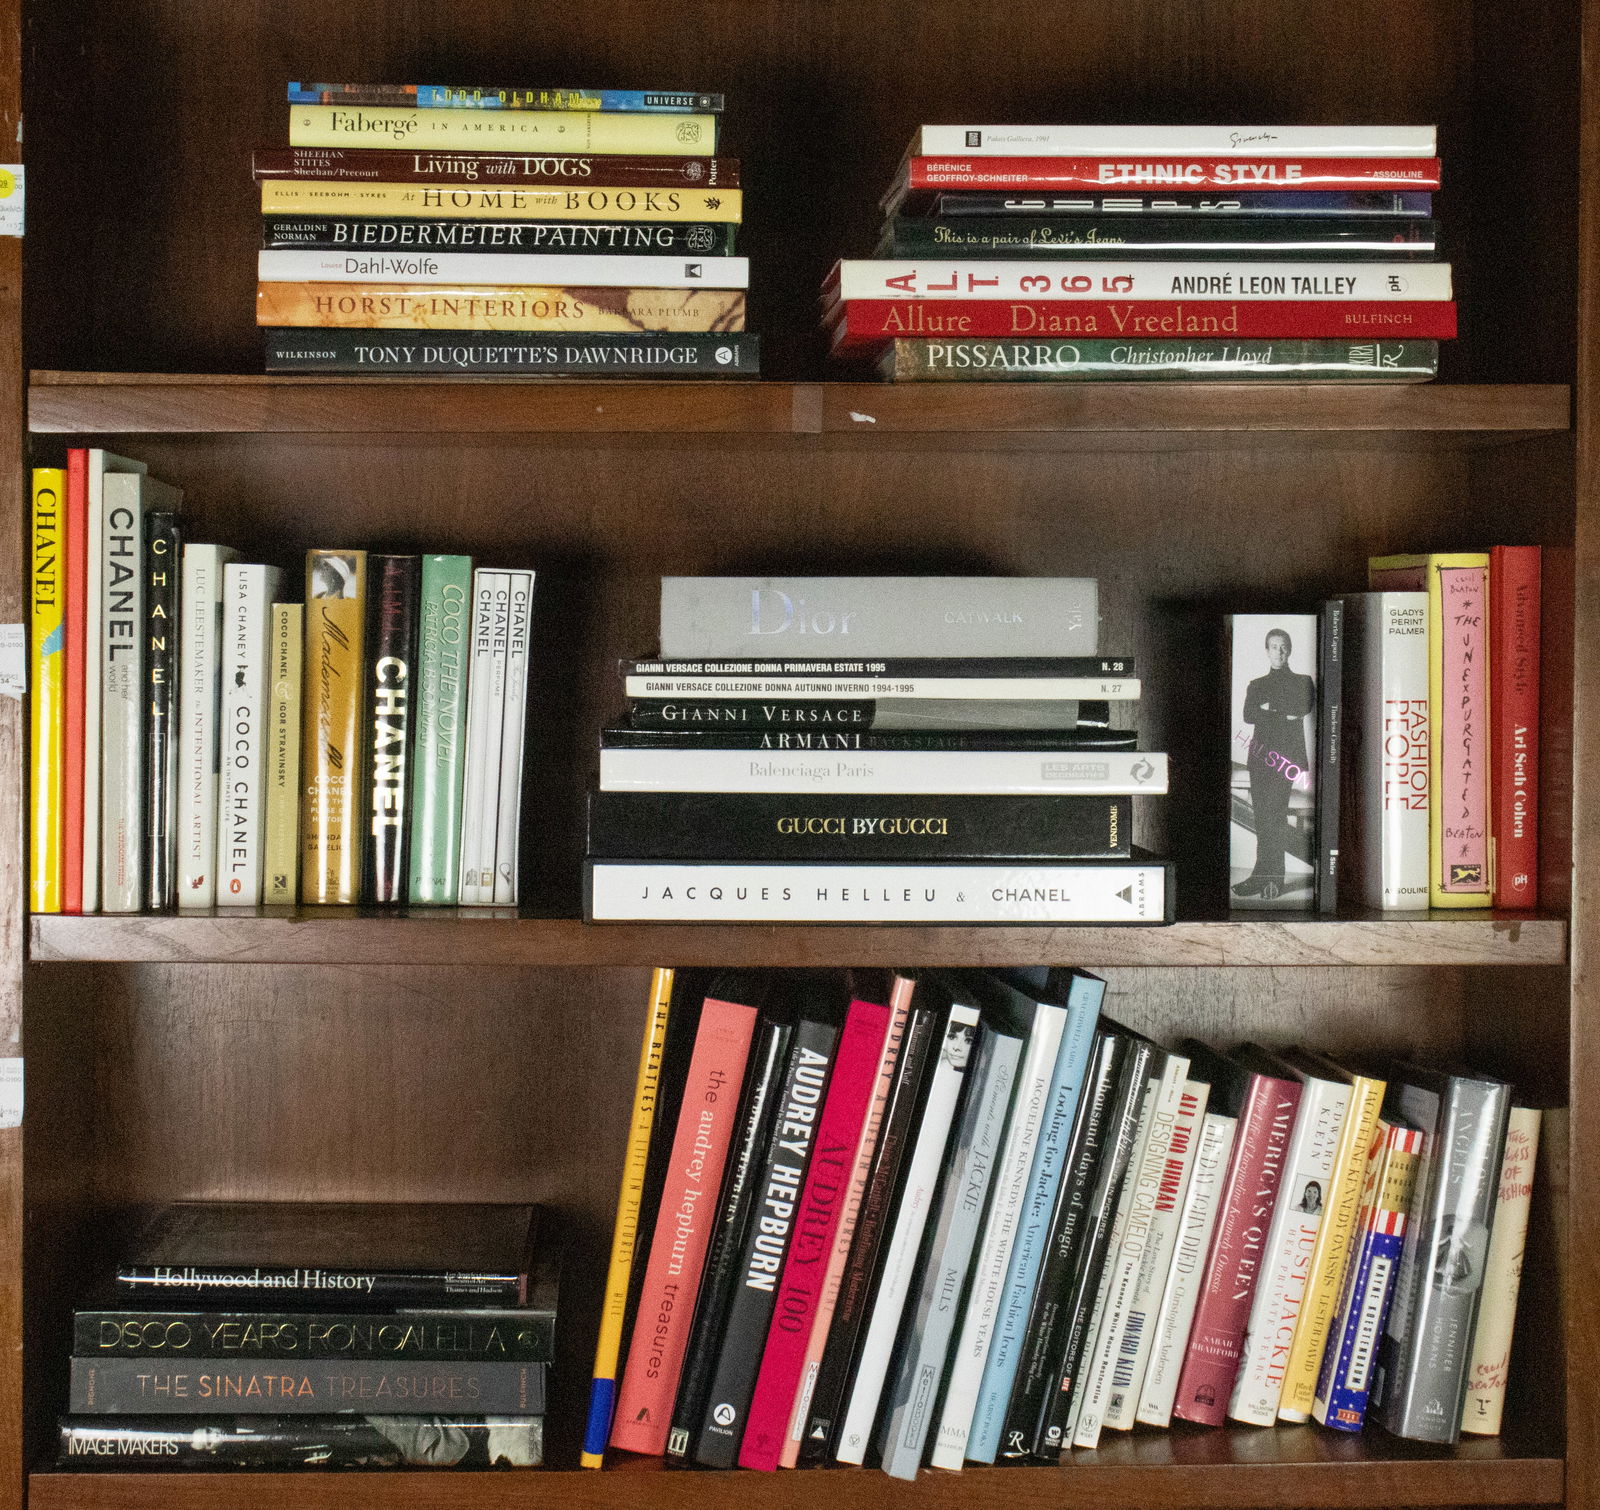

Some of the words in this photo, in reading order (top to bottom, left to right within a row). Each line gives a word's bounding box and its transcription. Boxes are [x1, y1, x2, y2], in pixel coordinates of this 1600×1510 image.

[647, 95, 694, 106] UNIVERSE
[331, 112, 418, 140] Fabergé
[431, 122, 449, 130] IN
[462, 123, 539, 133] AMERICA
[294, 150, 344, 159] SHEEHAN
[294, 159, 331, 167] STITES
[414, 154, 480, 181] Living
[485, 158, 517, 175] with
[523, 158, 592, 177] DOGS
[708, 159, 717, 185] Potter
[926, 174, 1028, 183] GEOFFROY-SCHNEITER
[1098, 164, 1208, 184] ETHNIC
[1214, 165, 1303, 184] STYLE
[1372, 171, 1423, 179] ASSOULINE
[421, 188, 527, 209] HOME
[535, 193, 558, 206] with
[565, 191, 680, 212] BOOKS
[273, 223, 328, 232] GERALDINE
[274, 232, 317, 241] NORMAN
[333, 223, 524, 245] BIEDERMEIER
[533, 227, 675, 247] PAINTING
[934, 226, 965, 243] This
[992, 230, 1019, 254] pair
[345, 258, 439, 276] Dahl-Wolfe
[1171, 273, 1232, 294] ANDRÉ
[1240, 277, 1285, 294] LEON
[1292, 277, 1356, 294] TALLEY
[315, 296, 411, 315] HORST
[882, 304, 971, 331] Allure
[1011, 305, 1099, 332] Diana
[1107, 305, 1238, 332] Vreeland
[1345, 314, 1412, 324] BULFINCH
[276, 351, 337, 359] WILKINSON
[354, 347, 416, 364] TONY
[565, 347, 698, 364] DAWNRIDGE
[927, 345, 1080, 368] PISSARRO
[36, 488, 56, 615] CHANEL
[109, 508, 134, 662] CHANEL
[196, 569, 205, 590] LUC
[239, 571, 248, 599] LISA
[152, 539, 167, 716] CHANEL
[478, 589, 491, 657] CHANEL
[494, 590, 507, 658] CHANEL
[511, 591, 526, 659] CHANEL
[744, 589, 857, 635] Dior
[1389, 609, 1424, 617] GLADYS
[238, 606, 247, 658] CHANEY
[1389, 627, 1425, 635] PALMER
[439, 652, 459, 692] THE
[636, 664, 663, 672] GIANNI
[666, 664, 702, 672] VERSACE
[705, 664, 752, 673] COLLEZIONE
[755, 664, 782, 672] DONNA
[784, 664, 832, 672] PRIMAVERA
[834, 663, 863, 672] ESTATE
[865, 662, 886, 672] 1995
[646, 683, 674, 691] GIANNI
[676, 683, 713, 691] VERSACE
[715, 683, 762, 692] COLLEZIONE
[765, 684, 793, 692] DONNA
[794, 684, 833, 692] AUTUNNO
[834, 684, 870, 693] INVERNO
[872, 684, 915, 693] 1994-1995
[278, 701, 287, 724] IGOR
[662, 705, 747, 721] GIANNI
[762, 706, 862, 722] VERSACE
[236, 707, 251, 769] COCO
[372, 656, 407, 836] CHANEL
[760, 733, 861, 749] ARMANI
[1410, 700, 1428, 810] FASHION
[1515, 725, 1527, 749] Ari
[749, 761, 831, 781] Balenciaga
[836, 763, 874, 777] Paris
[1514, 753, 1527, 787] Seth
[233, 782, 248, 872] CHANEL
[777, 818, 845, 834] GUCCI
[852, 818, 878, 835] BY
[879, 818, 948, 835] GUCCI
[1515, 791, 1526, 838] Cohen
[193, 816, 201, 858] ARTIST
[642, 887, 791, 900] JACQUES
[817, 888, 935, 902] HELLEU
[992, 888, 1071, 902] CHANEL
[881, 1009, 907, 1079] AUDREY
[642, 1041, 662, 1112] BEATLES
[705, 1071, 725, 1103] the
[779, 1049, 828, 1156] AUDREY
[1023, 1079, 1044, 1145] JACQUELINE
[1047, 1086, 1072, 1142] Looking
[1083, 1076, 1111, 1147] thousand
[686, 1111, 713, 1181] audrey
[1140, 1112, 1175, 1188] DESIGNING
[1312, 1108, 1330, 1158] KLEIN
[1323, 1102, 1344, 1171] EDWARD
[1044, 1147, 1059, 1167] for
[1076, 1153, 1093, 1186] days
[1235, 1147, 1253, 1202] Jacqueline
[963, 1146, 989, 1213] JACKIE
[1032, 1170, 1053, 1217] Jackie:
[1071, 1192, 1085, 1206] of
[1337, 1169, 1360, 1228] KENNEDY
[669, 1190, 701, 1275] hepburn
[745, 1164, 798, 1291] HEPBURN
[999, 1211, 1014, 1236] THE
[1059, 1213, 1076, 1257] magic
[1124, 1193, 1155, 1261] CAMELOT
[1220, 1205, 1240, 1251] Kennedy
[993, 1240, 1008, 1275] WHITE
[1018, 1225, 1040, 1279] American
[1234, 1227, 1261, 1299] QUEEN
[1291, 1225, 1316, 1285] JUST
[1325, 1235, 1344, 1286] ONASSIS
[154, 1267, 260, 1291] Hollywood
[263, 1269, 299, 1288] and
[303, 1269, 376, 1294] History
[939, 1269, 958, 1312] MILLS
[1212, 1254, 1229, 1294] Onassis
[1371, 1265, 1386, 1299] WAYNE
[780, 1288, 810, 1333] 100
[983, 1282, 998, 1318] HOUSE
[1006, 1285, 1026, 1331] Fashion
[1116, 1278, 1129, 1309] Kennedy
[1268, 1266, 1288, 1326] PRIVATE
[647, 1285, 678, 1378] treasures
[1075, 1305, 1086, 1322] THE
[1166, 1287, 1185, 1340] Christopher
[1313, 1295, 1330, 1336] LESTER
[99, 1321, 192, 1349] DISCO
[203, 1322, 298, 1350] YEARS
[975, 1325, 987, 1358] YEARS
[998, 1336, 1014, 1367] Icons
[1067, 1324, 1082, 1361] EDITORS
[1266, 1295, 1300, 1391] JACKIE
[1353, 1306, 1377, 1384] KOESTENBAUM
[1428, 1317, 1442, 1370] HOMANS
[1443, 1318, 1458, 1372] JENNIFER
[1155, 1345, 1173, 1385] Andersen
[1256, 1336, 1271, 1380] YEARS
[1305, 1339, 1320, 1372] DAVID
[137, 1375, 188, 1397] THE
[198, 1375, 315, 1398] SINATRA
[326, 1375, 481, 1399] TREASURES
[68, 1437, 114, 1456] IMAGE
[117, 1437, 179, 1456] MAKERS
